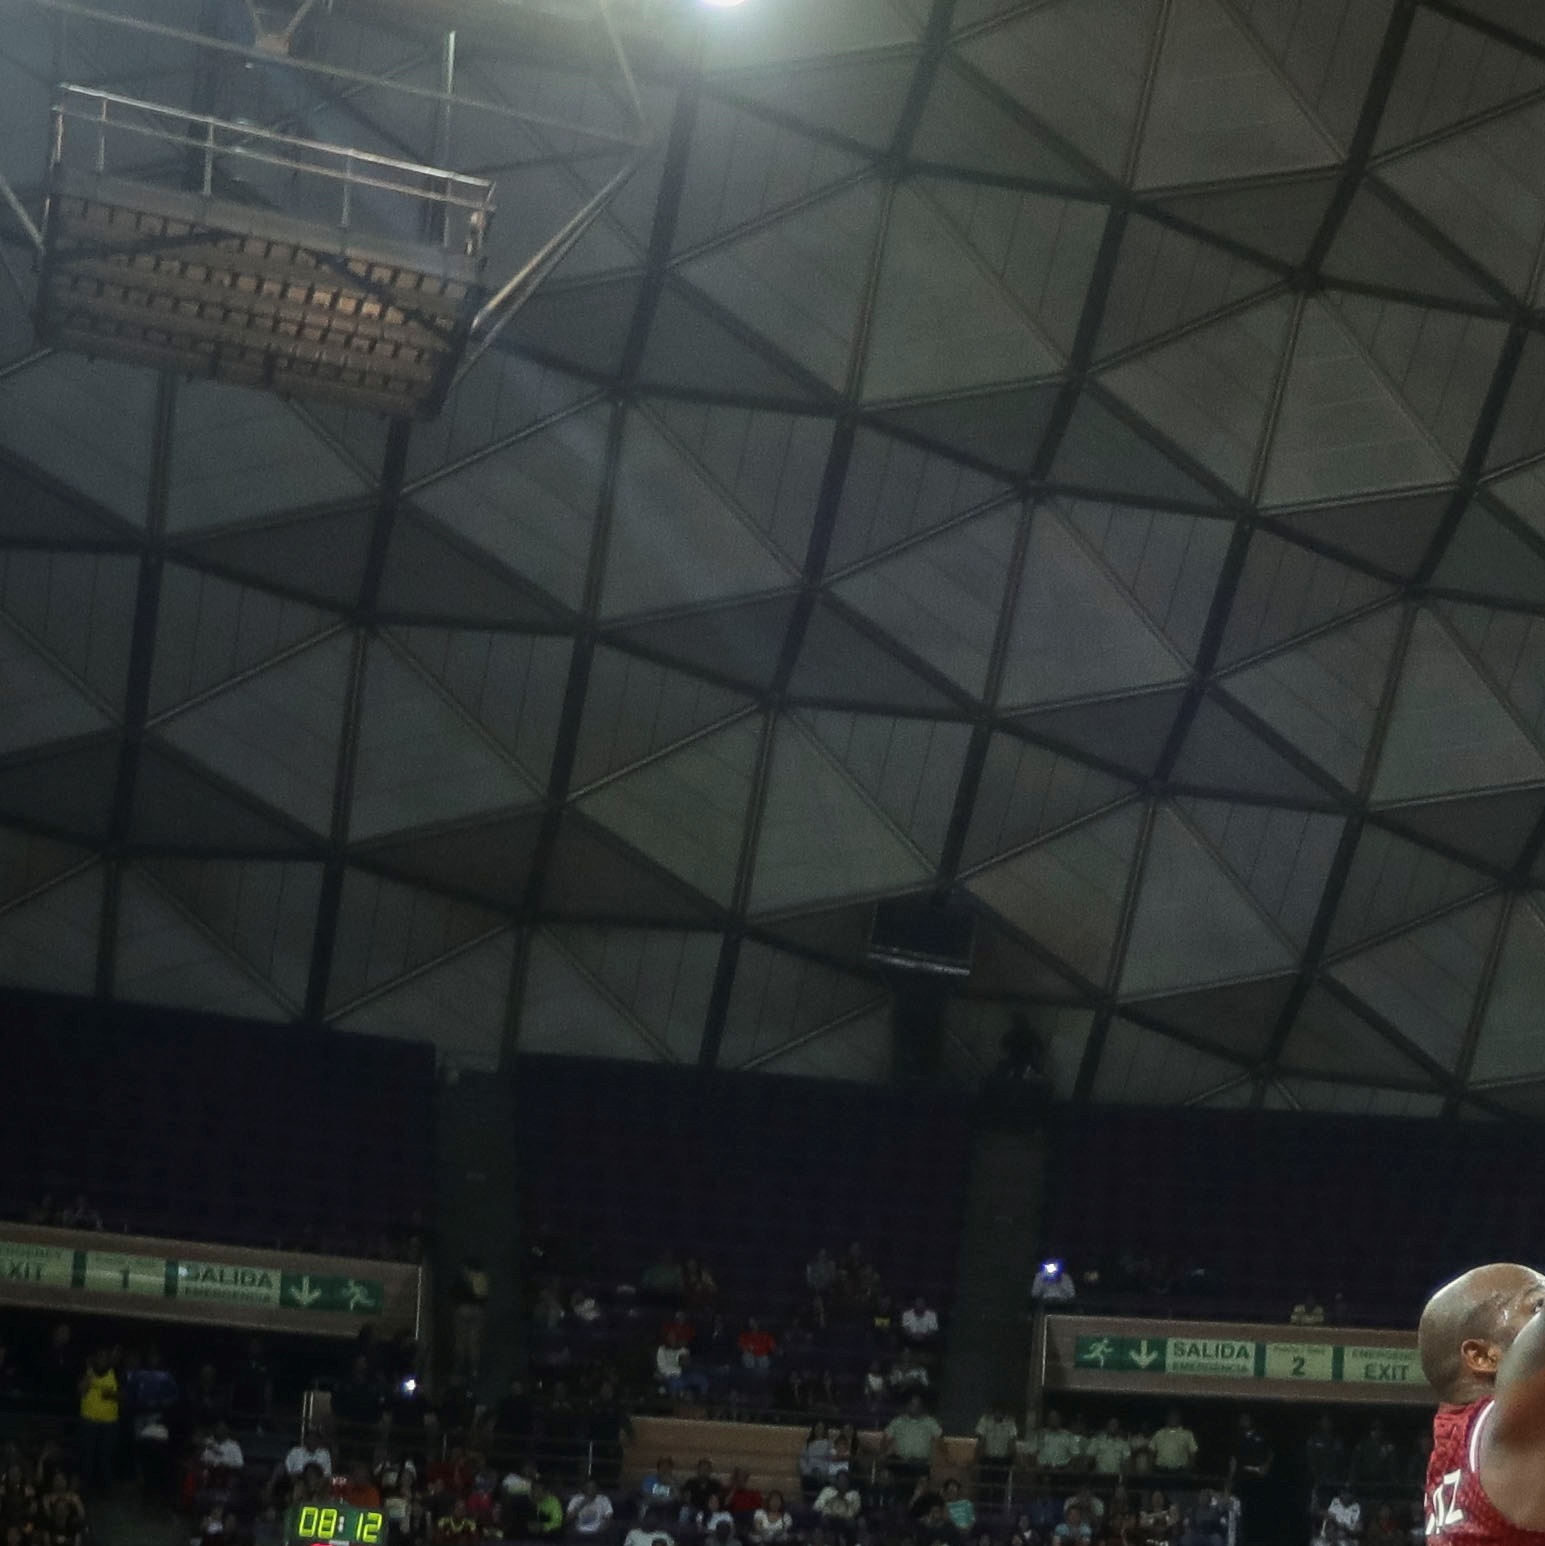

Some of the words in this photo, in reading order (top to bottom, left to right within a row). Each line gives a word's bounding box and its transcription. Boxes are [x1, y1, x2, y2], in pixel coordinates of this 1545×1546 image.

[187, 1263, 273, 1288] SALIDA
[1173, 1341, 1250, 1360] SALIDA
[1291, 1356, 1305, 1377] 2
[1364, 1363, 1409, 1380] EXIT
[300, 1506, 383, 1544] 08:12
